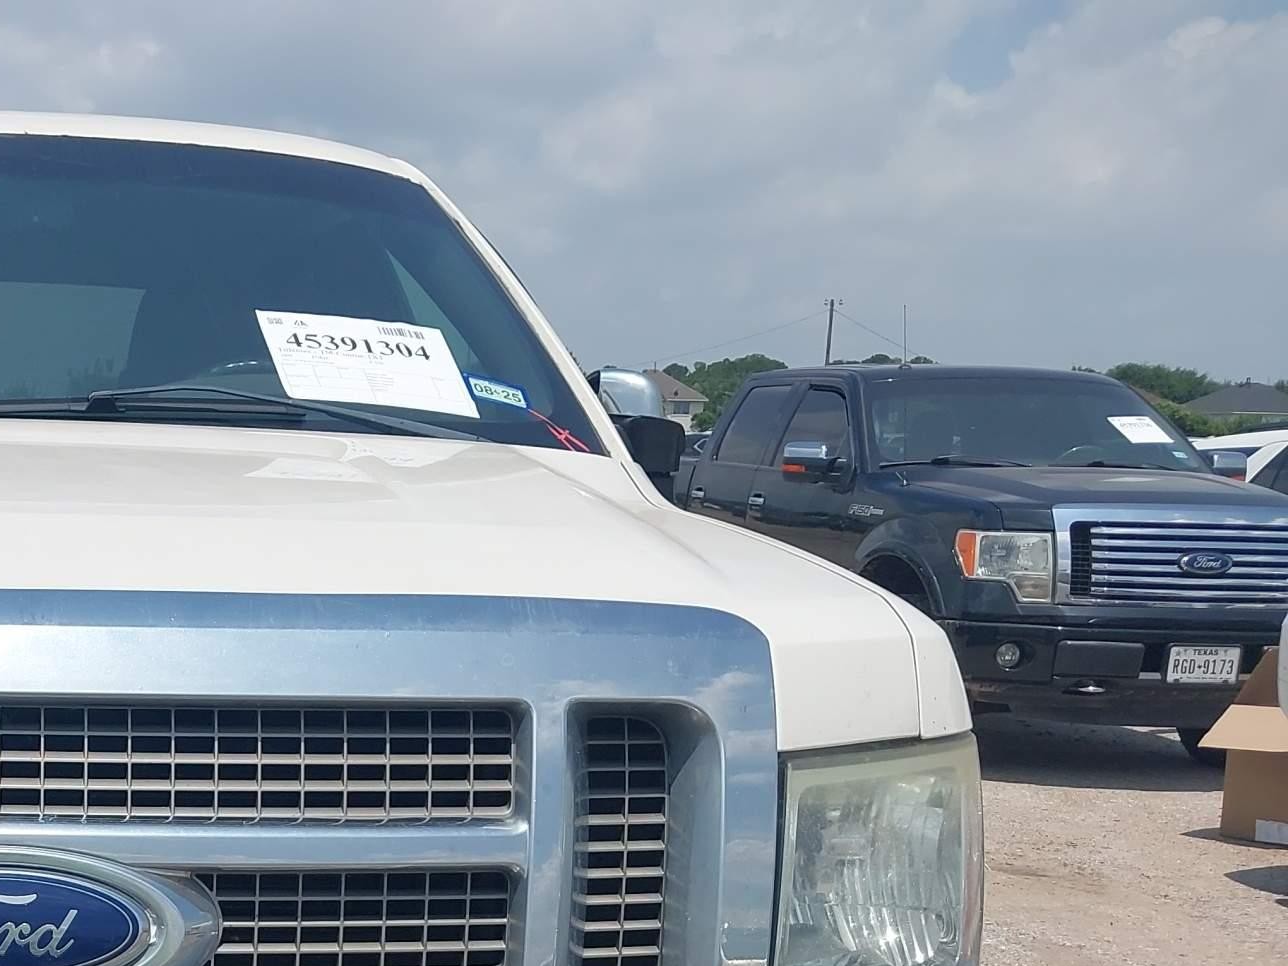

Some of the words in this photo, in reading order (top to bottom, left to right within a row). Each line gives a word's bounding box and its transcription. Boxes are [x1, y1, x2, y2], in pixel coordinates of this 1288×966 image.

[285, 332, 432, 361] 45391304
[1193, 555, 1223, 569] Ford
[1192, 648, 1220, 656] TEXAS
